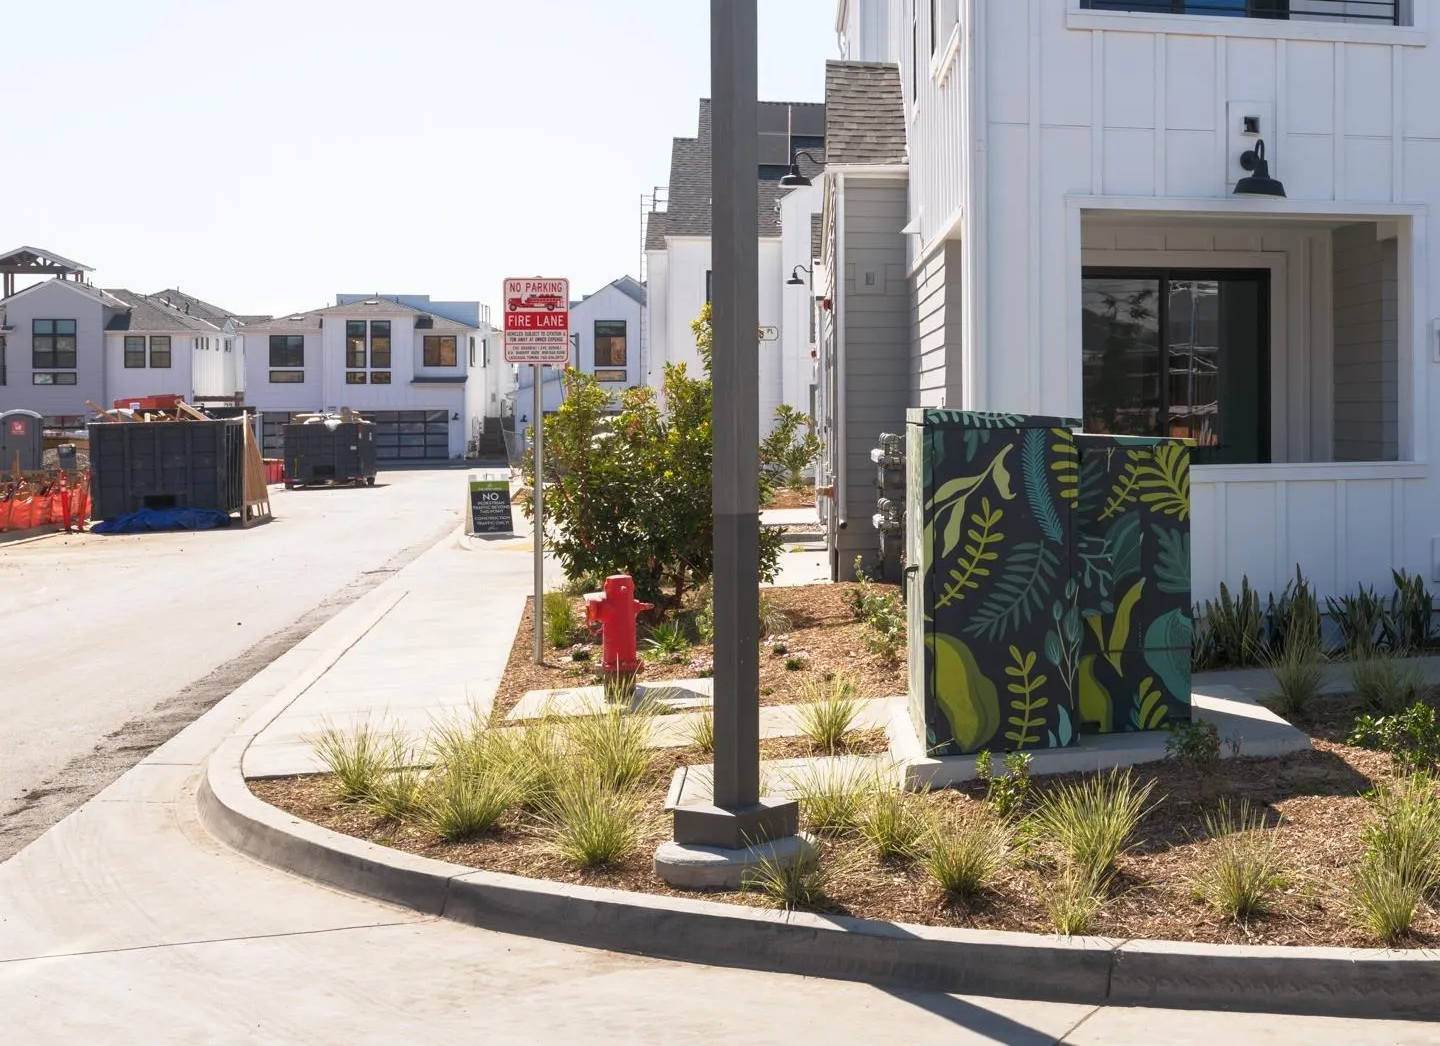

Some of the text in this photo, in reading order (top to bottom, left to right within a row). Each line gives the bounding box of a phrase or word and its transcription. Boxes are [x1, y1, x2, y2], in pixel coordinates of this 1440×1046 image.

[509, 282, 563, 293] NO PARKING
[508, 315, 564, 327] FIRE LANE
[482, 492, 499, 501] NO
